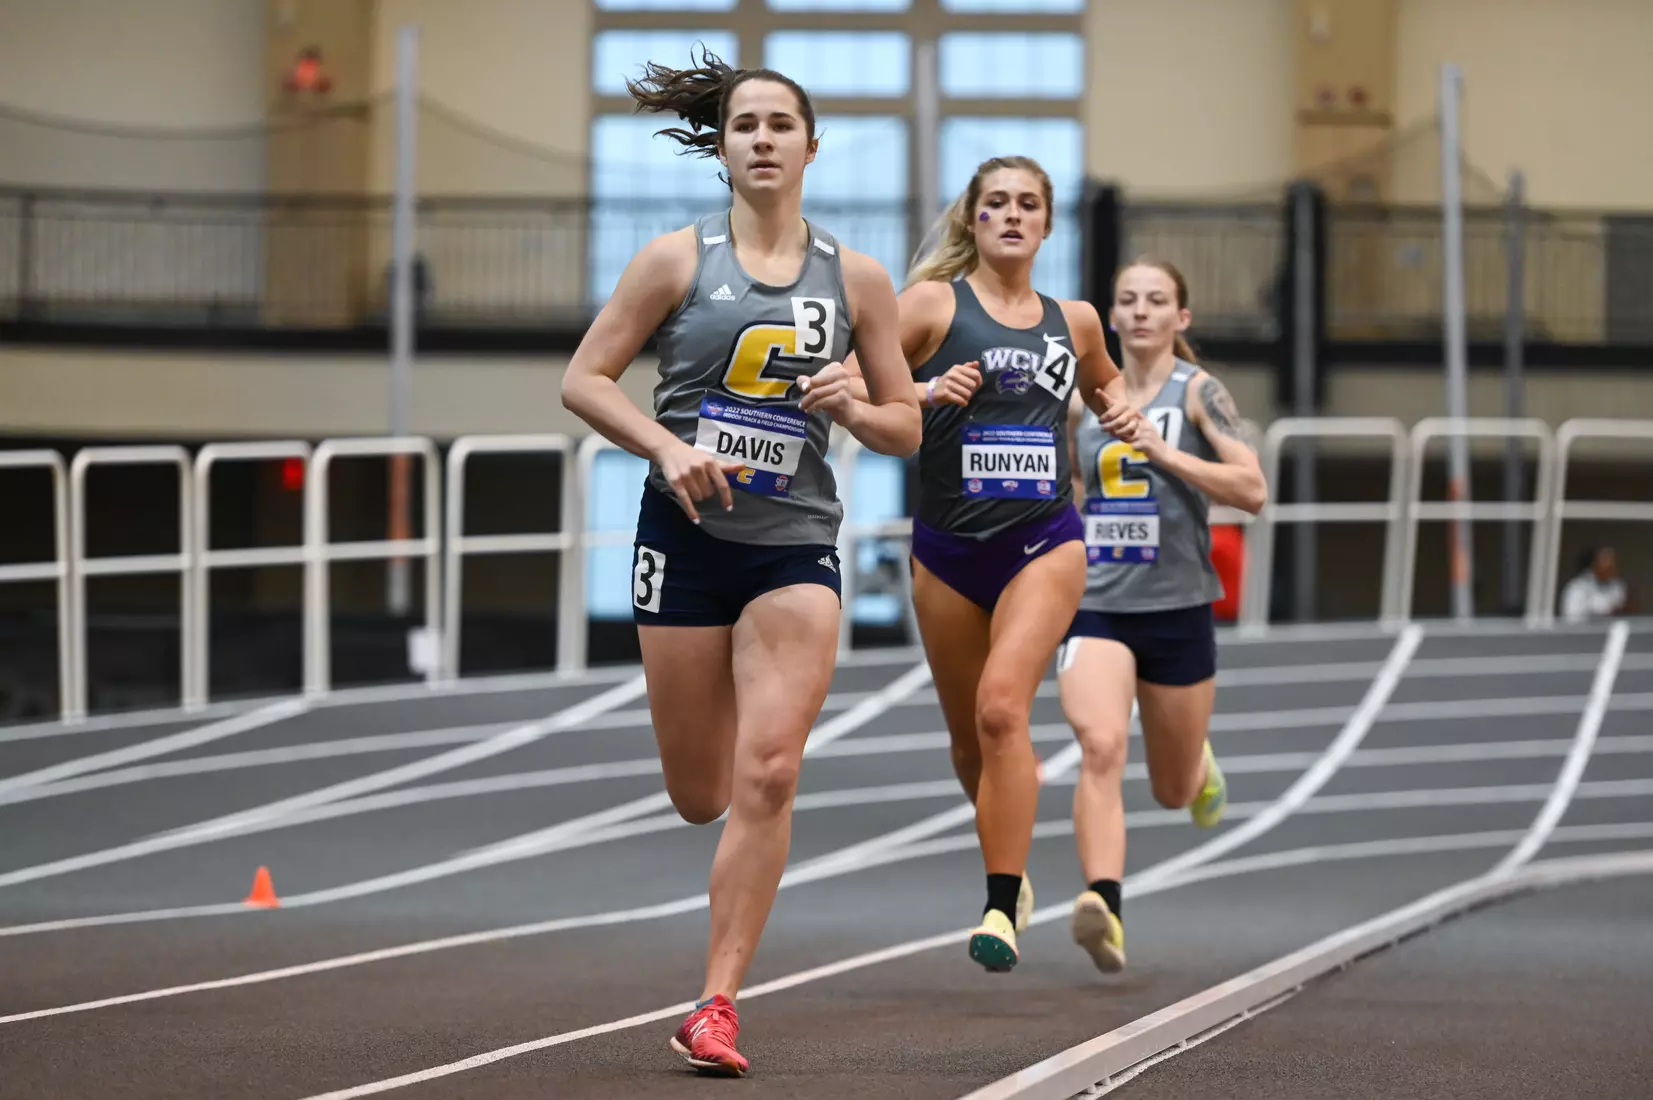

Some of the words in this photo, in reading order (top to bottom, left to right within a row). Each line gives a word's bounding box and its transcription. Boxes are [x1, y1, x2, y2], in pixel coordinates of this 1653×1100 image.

[709, 293, 736, 302] adidas
[803, 300, 827, 354] 3
[1044, 352, 1071, 392] 4
[723, 412, 742, 420] INDOOR
[742, 416, 757, 424] TRACK
[761, 419, 773, 427] FIELD
[773, 423, 805, 434] CHAMPIONSHIPS
[724, 406, 740, 415] 2022
[740, 408, 773, 420] SOUTHERN
[772, 414, 806, 428] CONFERENCE
[1157, 412, 1171, 442] 1
[716, 431, 785, 466] DAVIS
[970, 453, 1049, 473] RUNYAN
[1097, 439, 1152, 499] C
[636, 551, 656, 606] 3
